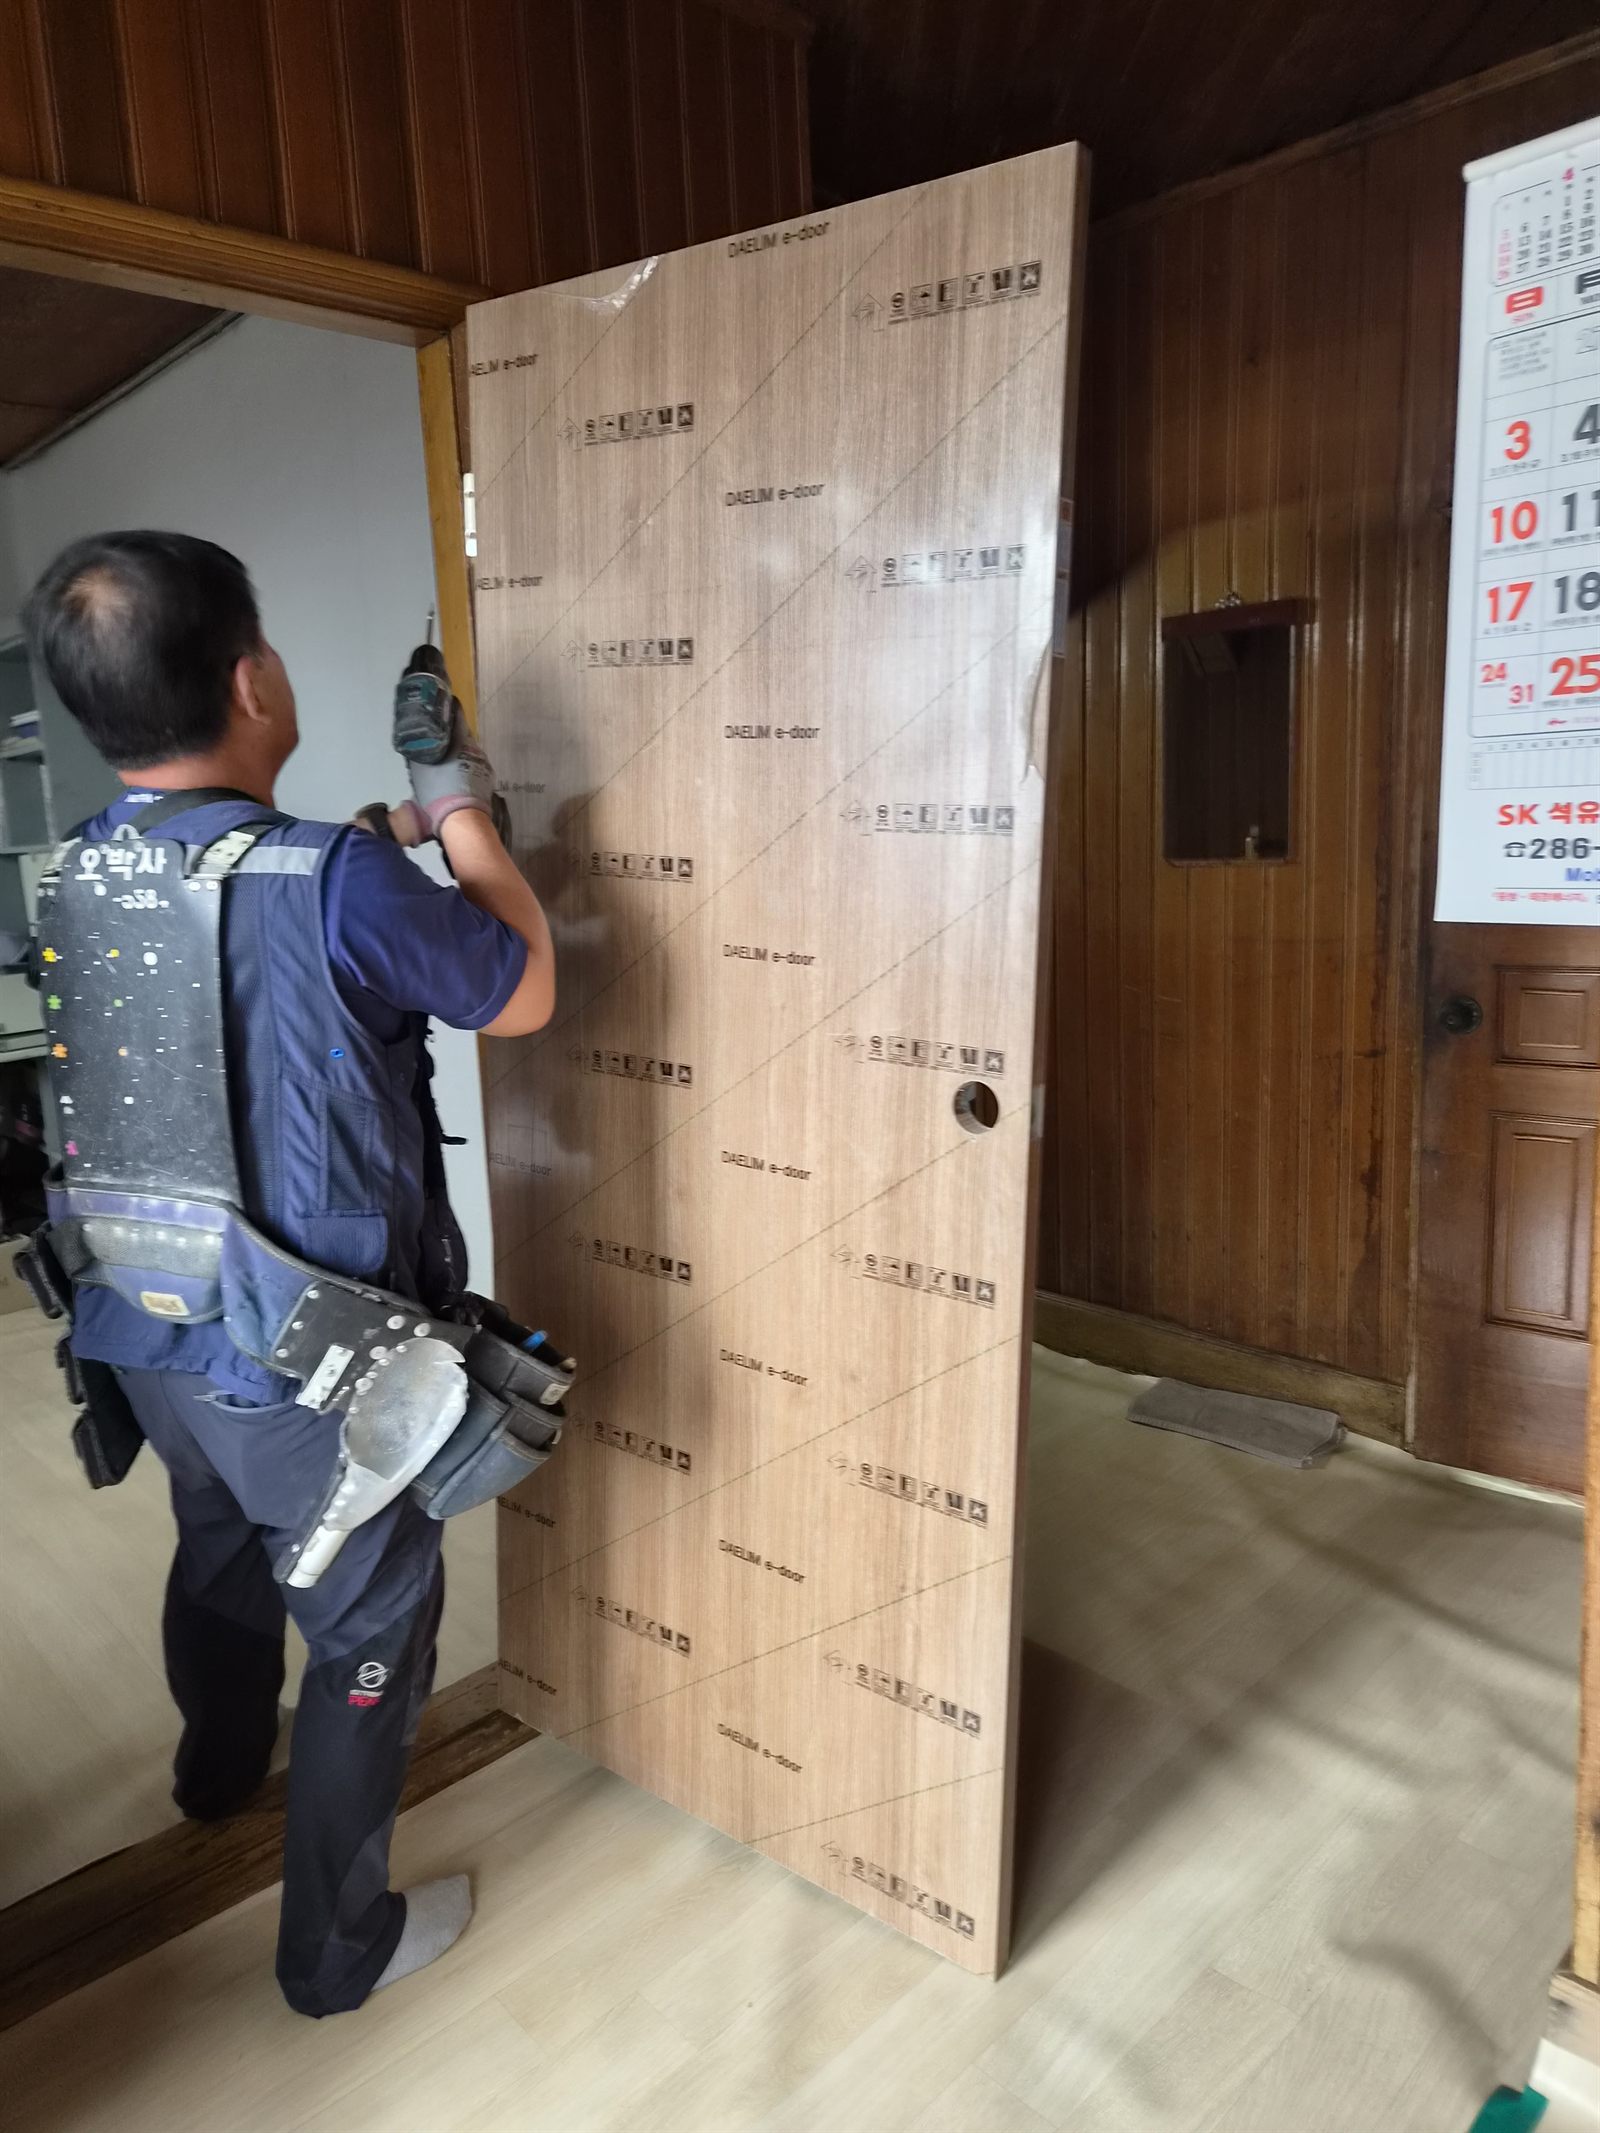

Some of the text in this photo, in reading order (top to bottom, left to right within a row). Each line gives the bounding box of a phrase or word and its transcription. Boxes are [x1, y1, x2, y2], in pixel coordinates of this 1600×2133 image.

[727, 221, 829, 258] DAELIM e-door
[503, 353, 538, 370] e-door
[1504, 404, 1600, 460] 3 4
[725, 483, 825, 507] DAELIM e-door
[1490, 501, 1538, 544] 10
[509, 575, 543, 588] e-door
[1487, 572, 1600, 624] 17 18
[1481, 654, 1600, 697] 24 25
[1508, 684, 1535, 704] 31
[724, 725, 821, 739] DAELIM e-door
[1498, 803, 1540, 825] SK
[75, 847, 168, 880] 오박사
[722, 944, 816, 966] DAELIM e-door
[721, 1150, 812, 1180] DAELIM e-door
[719, 1349, 808, 1387] DAELIM e-door
[718, 1539, 806, 1584] DAELIM e-door
[717, 1723, 803, 1773] DAELIM e-door
